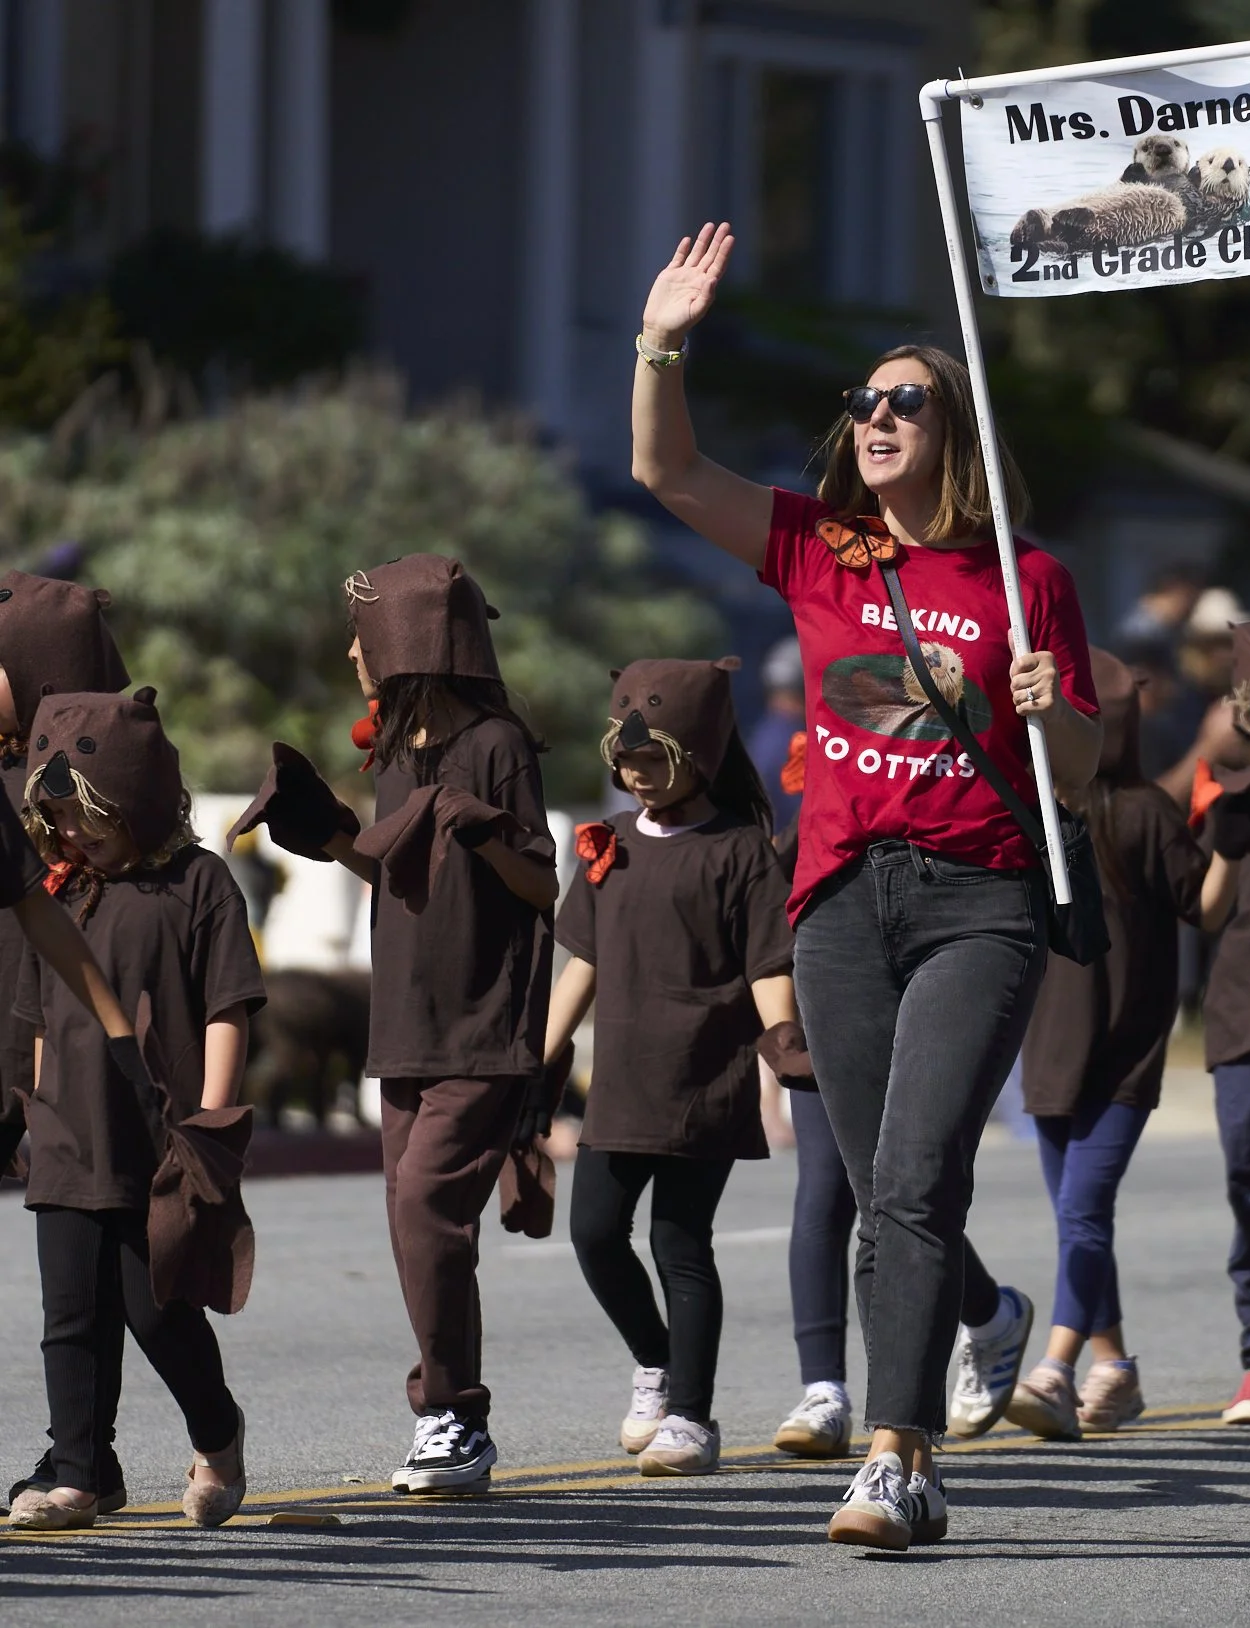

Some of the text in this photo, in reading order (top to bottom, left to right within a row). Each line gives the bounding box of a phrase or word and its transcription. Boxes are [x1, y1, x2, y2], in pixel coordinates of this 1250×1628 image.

[1005, 102, 1109, 144] Mrs.
[1010, 241, 1079, 282] 2nd
[1092, 233, 1207, 277] Grade
[861, 603, 981, 641] BE KIND
[815, 724, 975, 781] TO OTTERS
